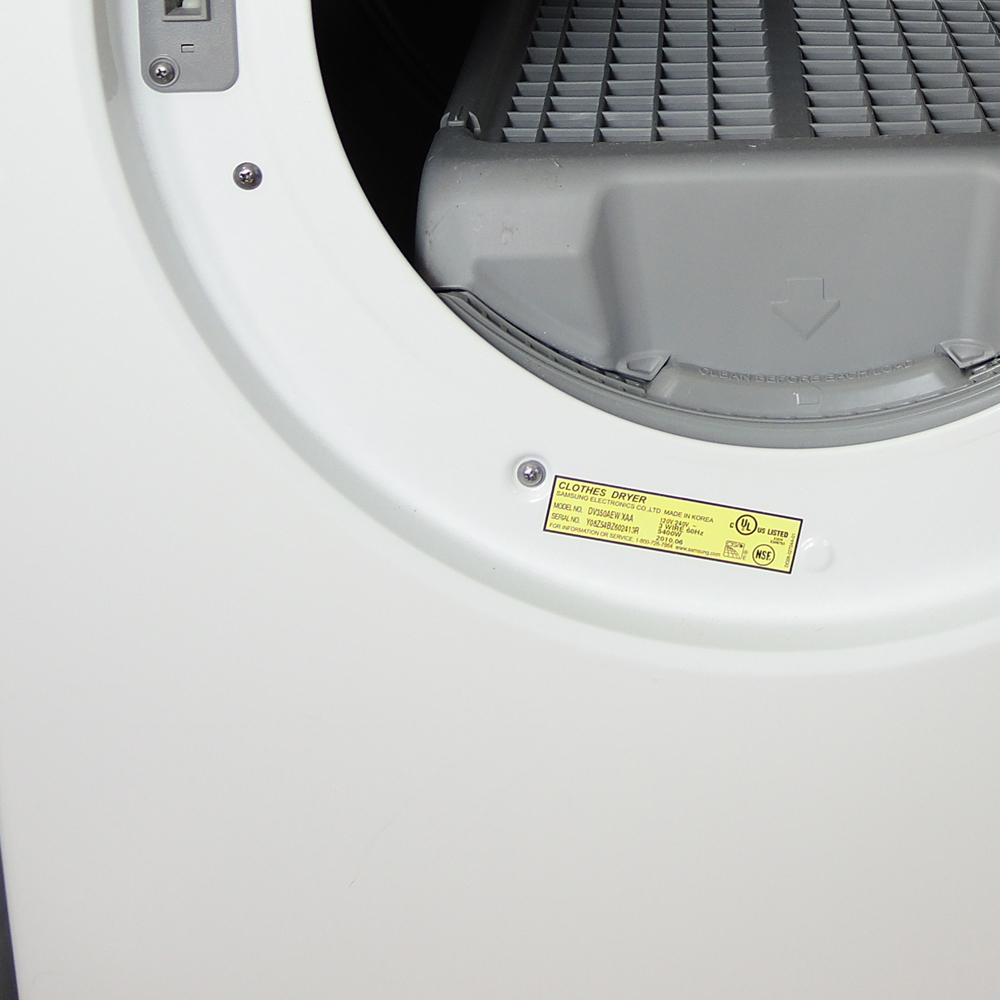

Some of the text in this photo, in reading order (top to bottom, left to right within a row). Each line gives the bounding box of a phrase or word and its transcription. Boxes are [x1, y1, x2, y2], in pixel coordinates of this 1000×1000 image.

[699, 359, 915, 384] CLEAN BEFORE EACH LOAD
[558, 481, 647, 504] CLOTHES DRYER
[554, 502, 573, 511] MODEL
[556, 490, 588, 501] SAMSUNG
[590, 496, 635, 509] ELECTRONICS
[664, 509, 682, 517] MADE
[691, 514, 714, 523] KOREA
[551, 513, 570, 522] SERIAL
[562, 525, 600, 536] INFORMATION
[665, 524, 684, 532] WIRE
[767, 529, 789, 539] LISTED
[755, 549, 772, 561] NSF
